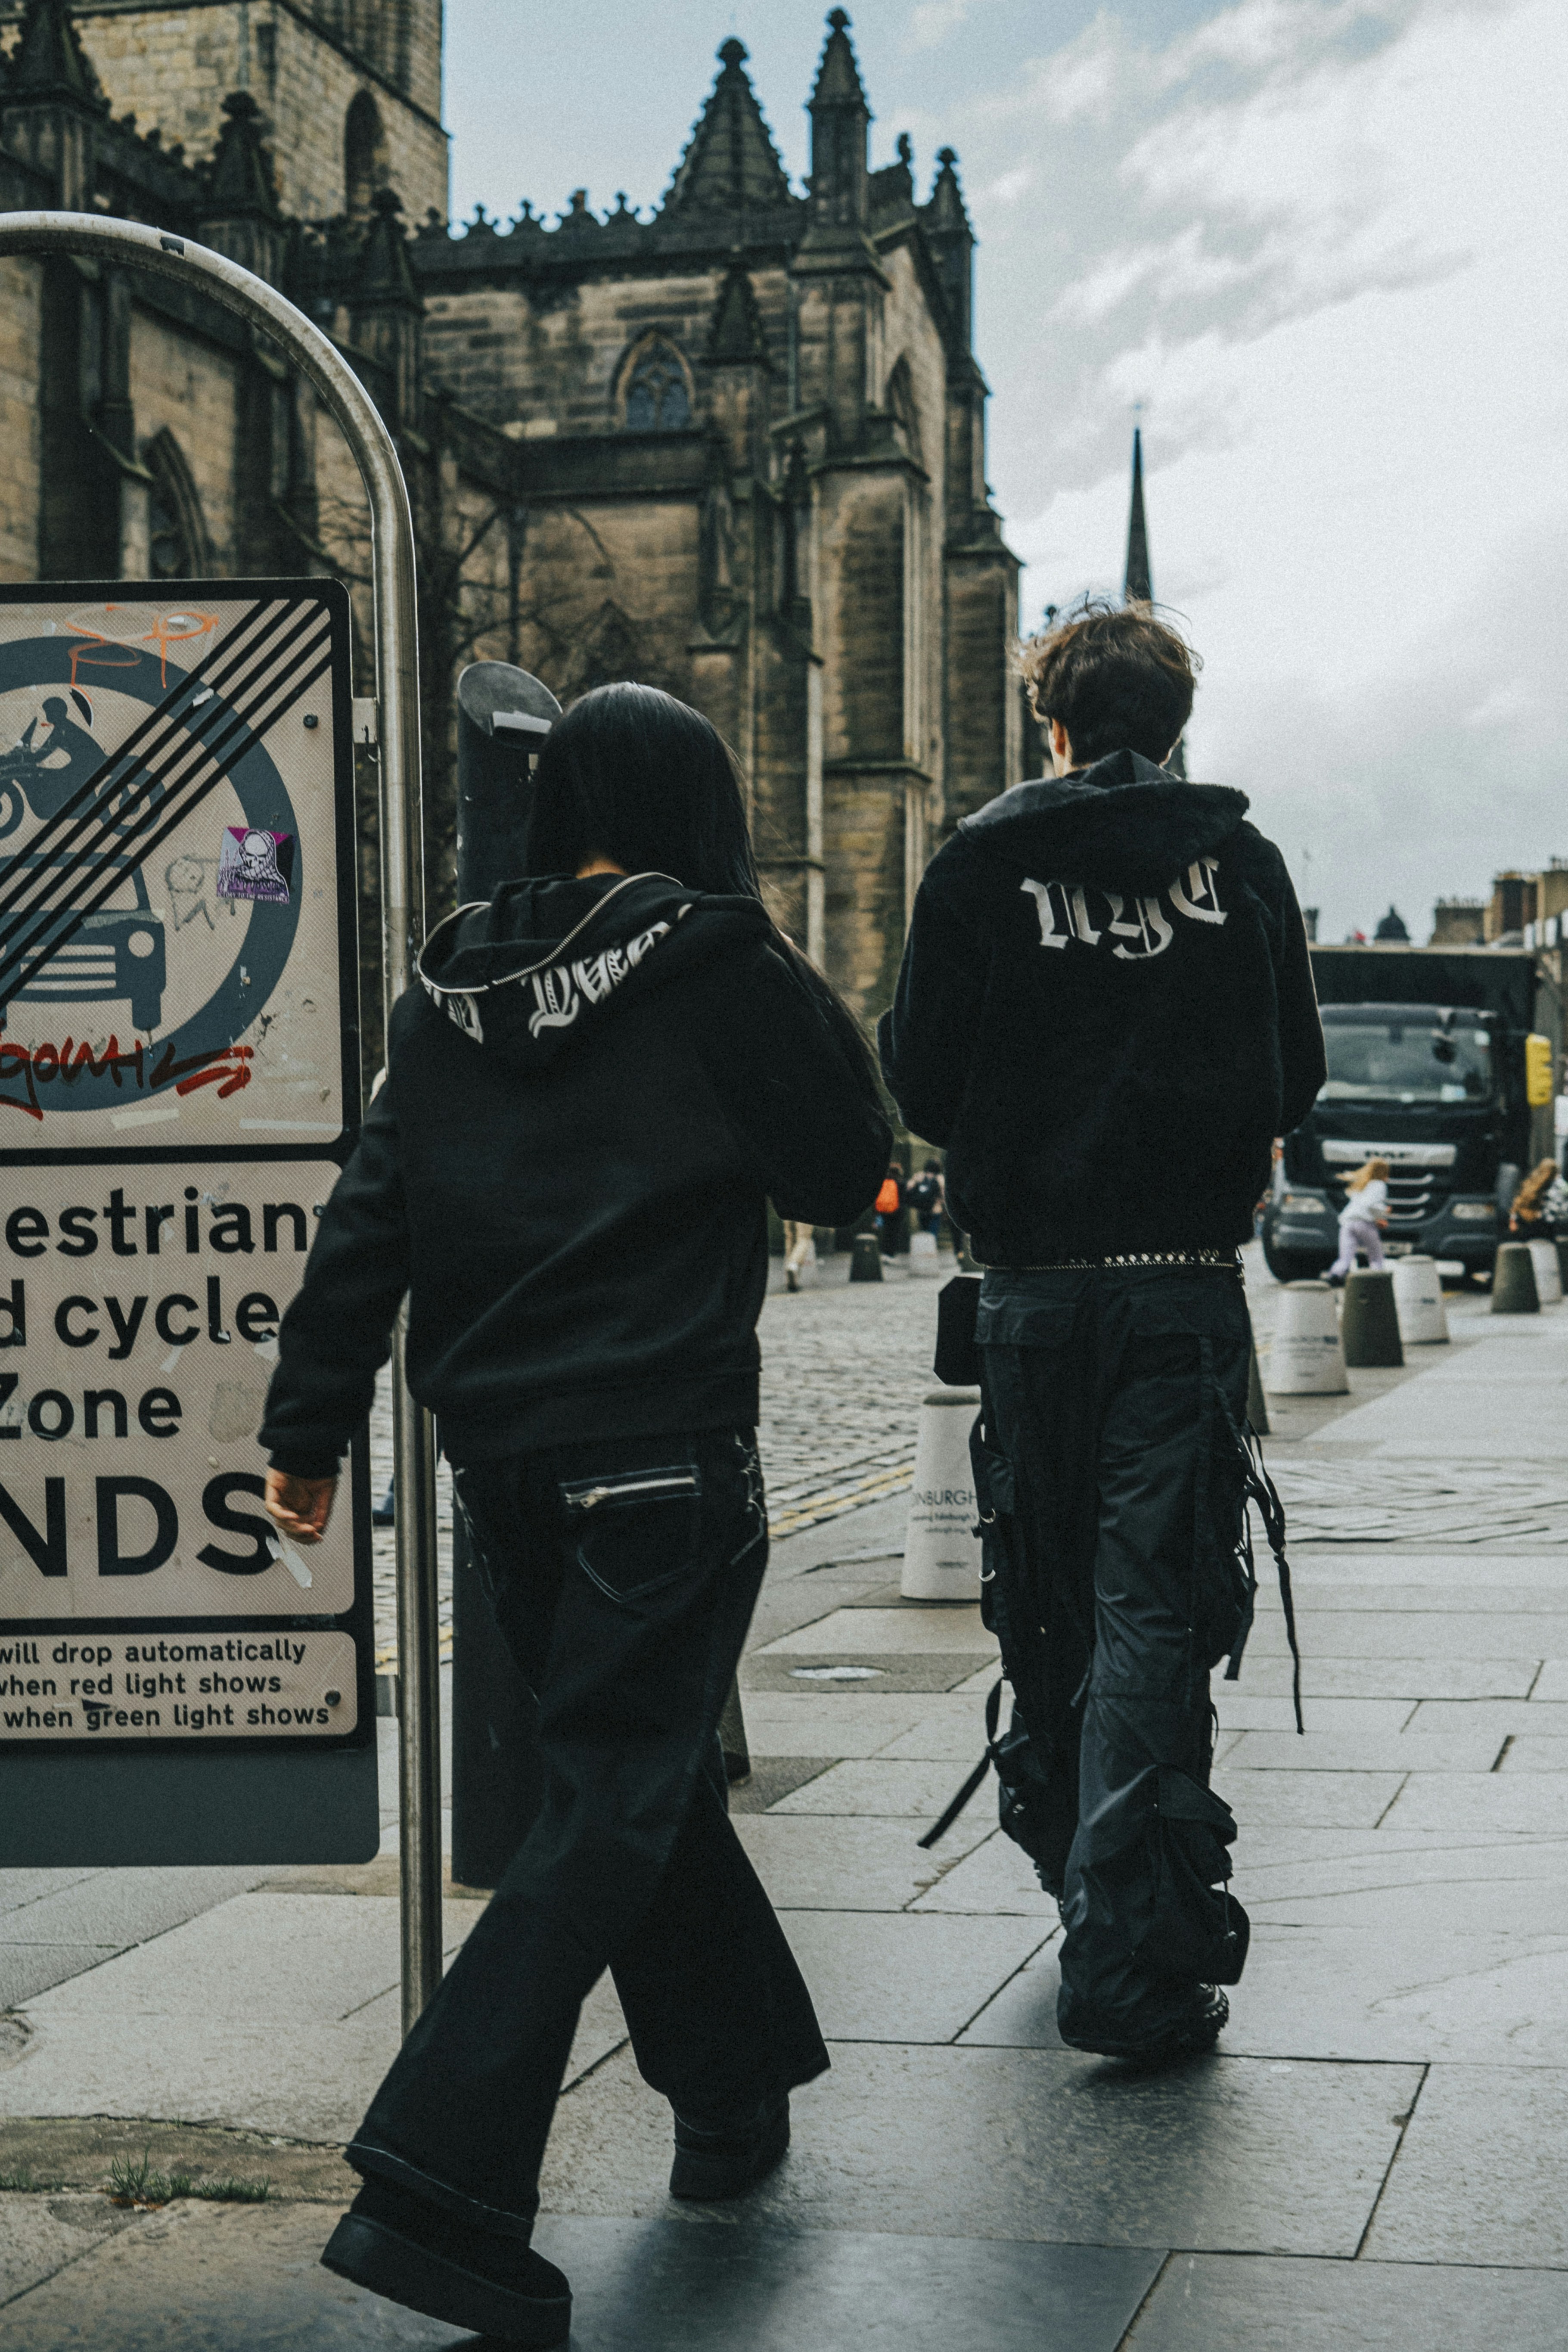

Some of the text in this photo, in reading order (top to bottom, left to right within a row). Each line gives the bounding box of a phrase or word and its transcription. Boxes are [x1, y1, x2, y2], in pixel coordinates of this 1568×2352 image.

[54, 1275, 280, 1361] cycle
[52, 1642, 112, 1667] drop
[125, 1639, 306, 1665] automatically
[70, 1673, 113, 1695] red
[126, 1672, 186, 1699] light
[199, 1672, 281, 1693] shows
[3, 1703, 329, 1732] when green light shows
